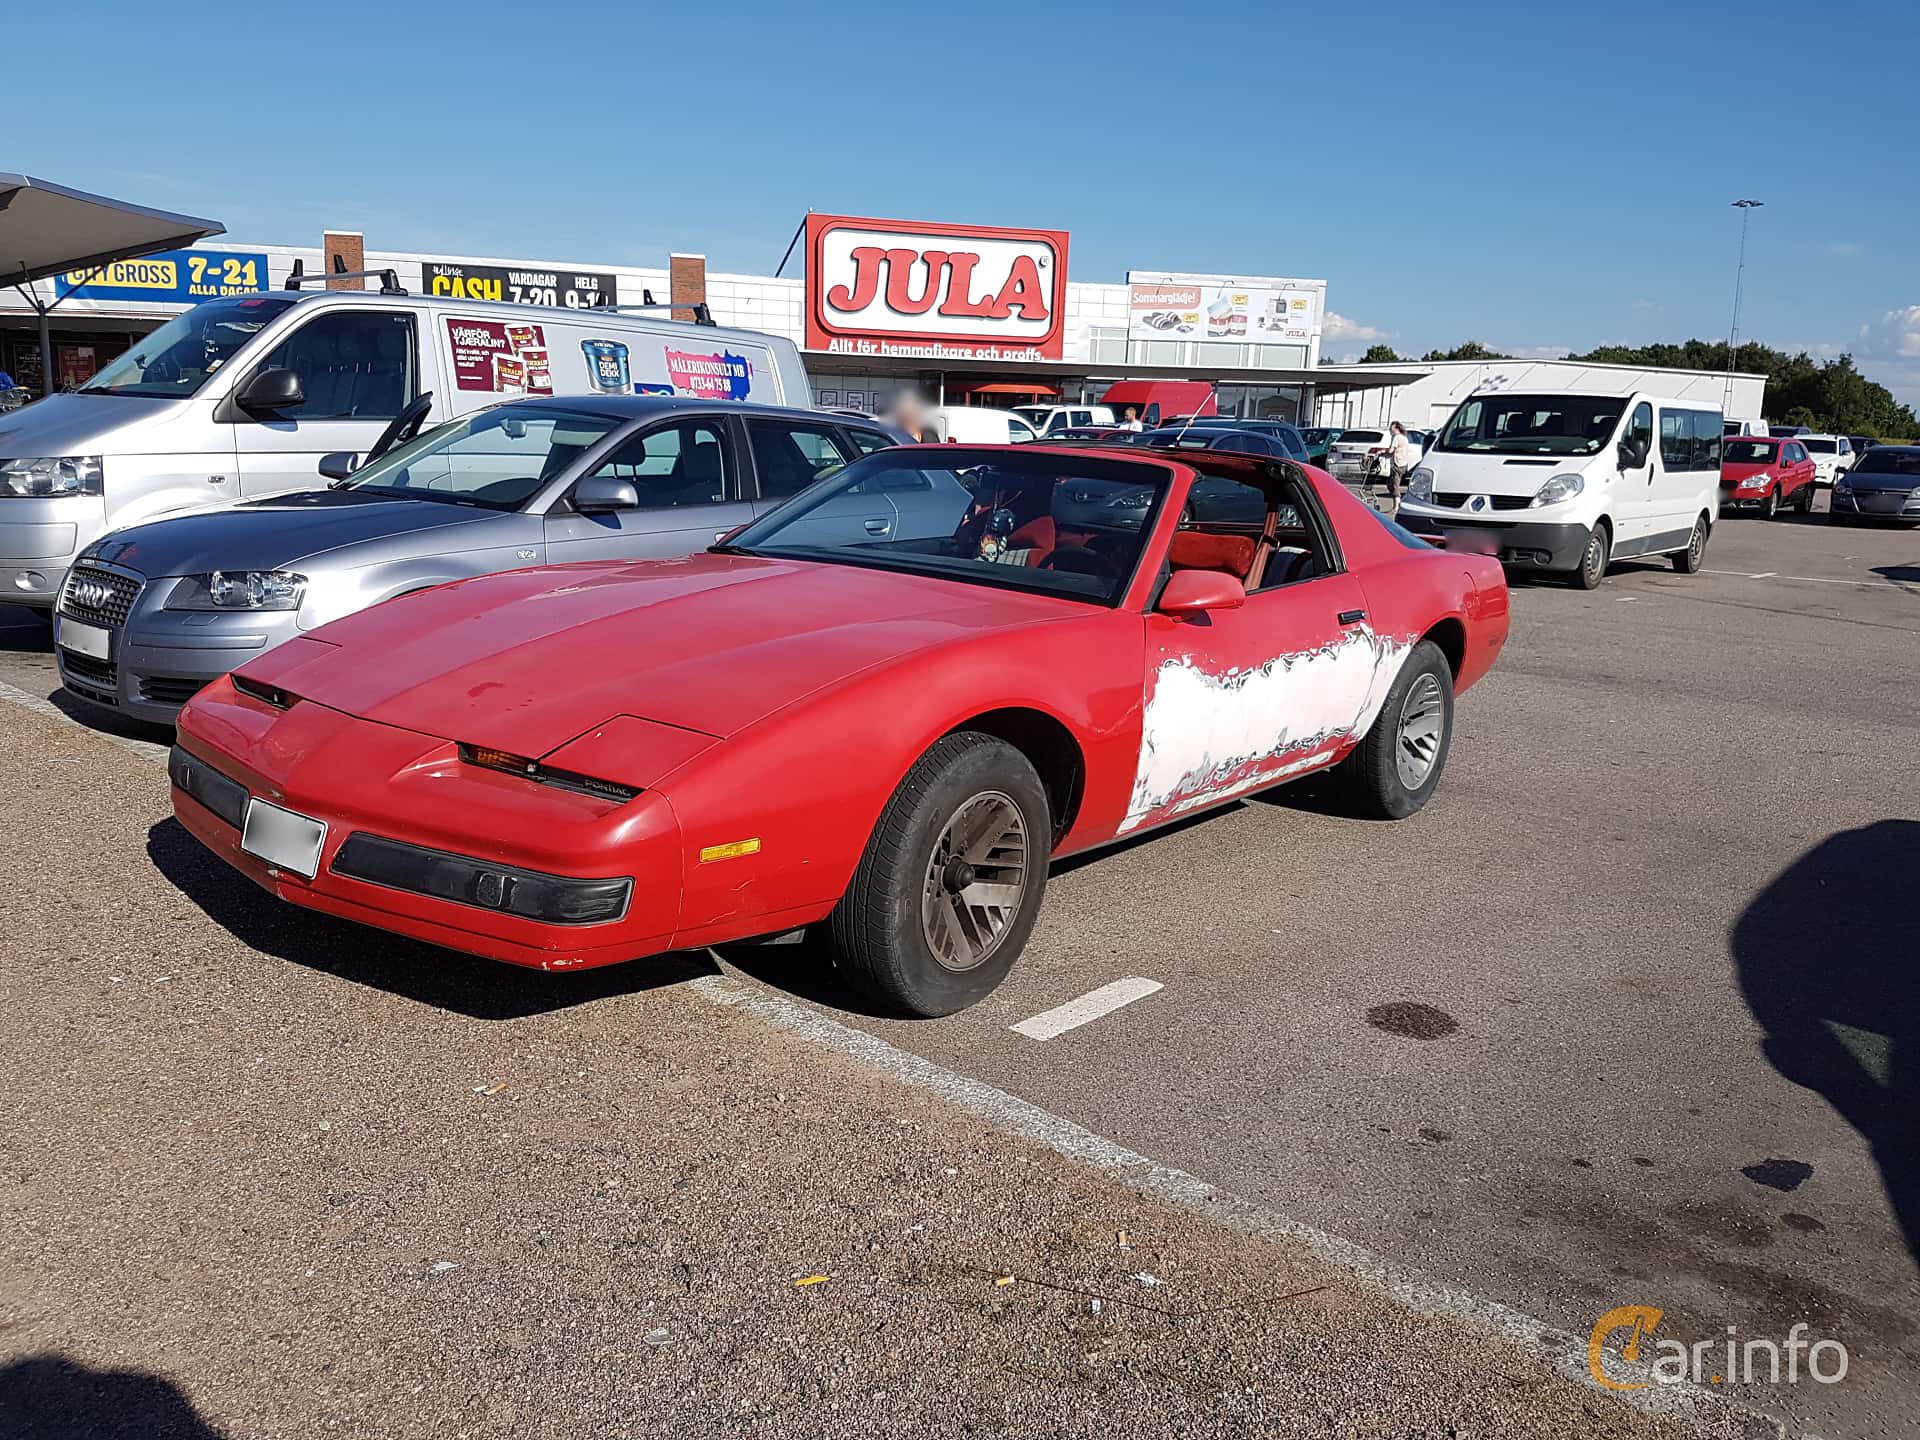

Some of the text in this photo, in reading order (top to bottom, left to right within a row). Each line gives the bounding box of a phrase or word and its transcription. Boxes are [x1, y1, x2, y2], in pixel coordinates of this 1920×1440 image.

[113, 263, 171, 283] GROSS
[188, 257, 258, 286] 7-21
[508, 272, 557, 287] VARDAGAR
[188, 284, 217, 296] ALLA
[432, 275, 502, 302] CASH
[574, 276, 598, 290] HELG
[827, 246, 1049, 320] JULA
[829, 339, 853, 353] Allt
[857, 341, 878, 354] för
[881, 340, 973, 358] hemmafixare
[975, 345, 999, 359] och
[670, 356, 745, 378] MÅLERIKONSULT MB
[585, 779, 631, 797] PONTIAC
